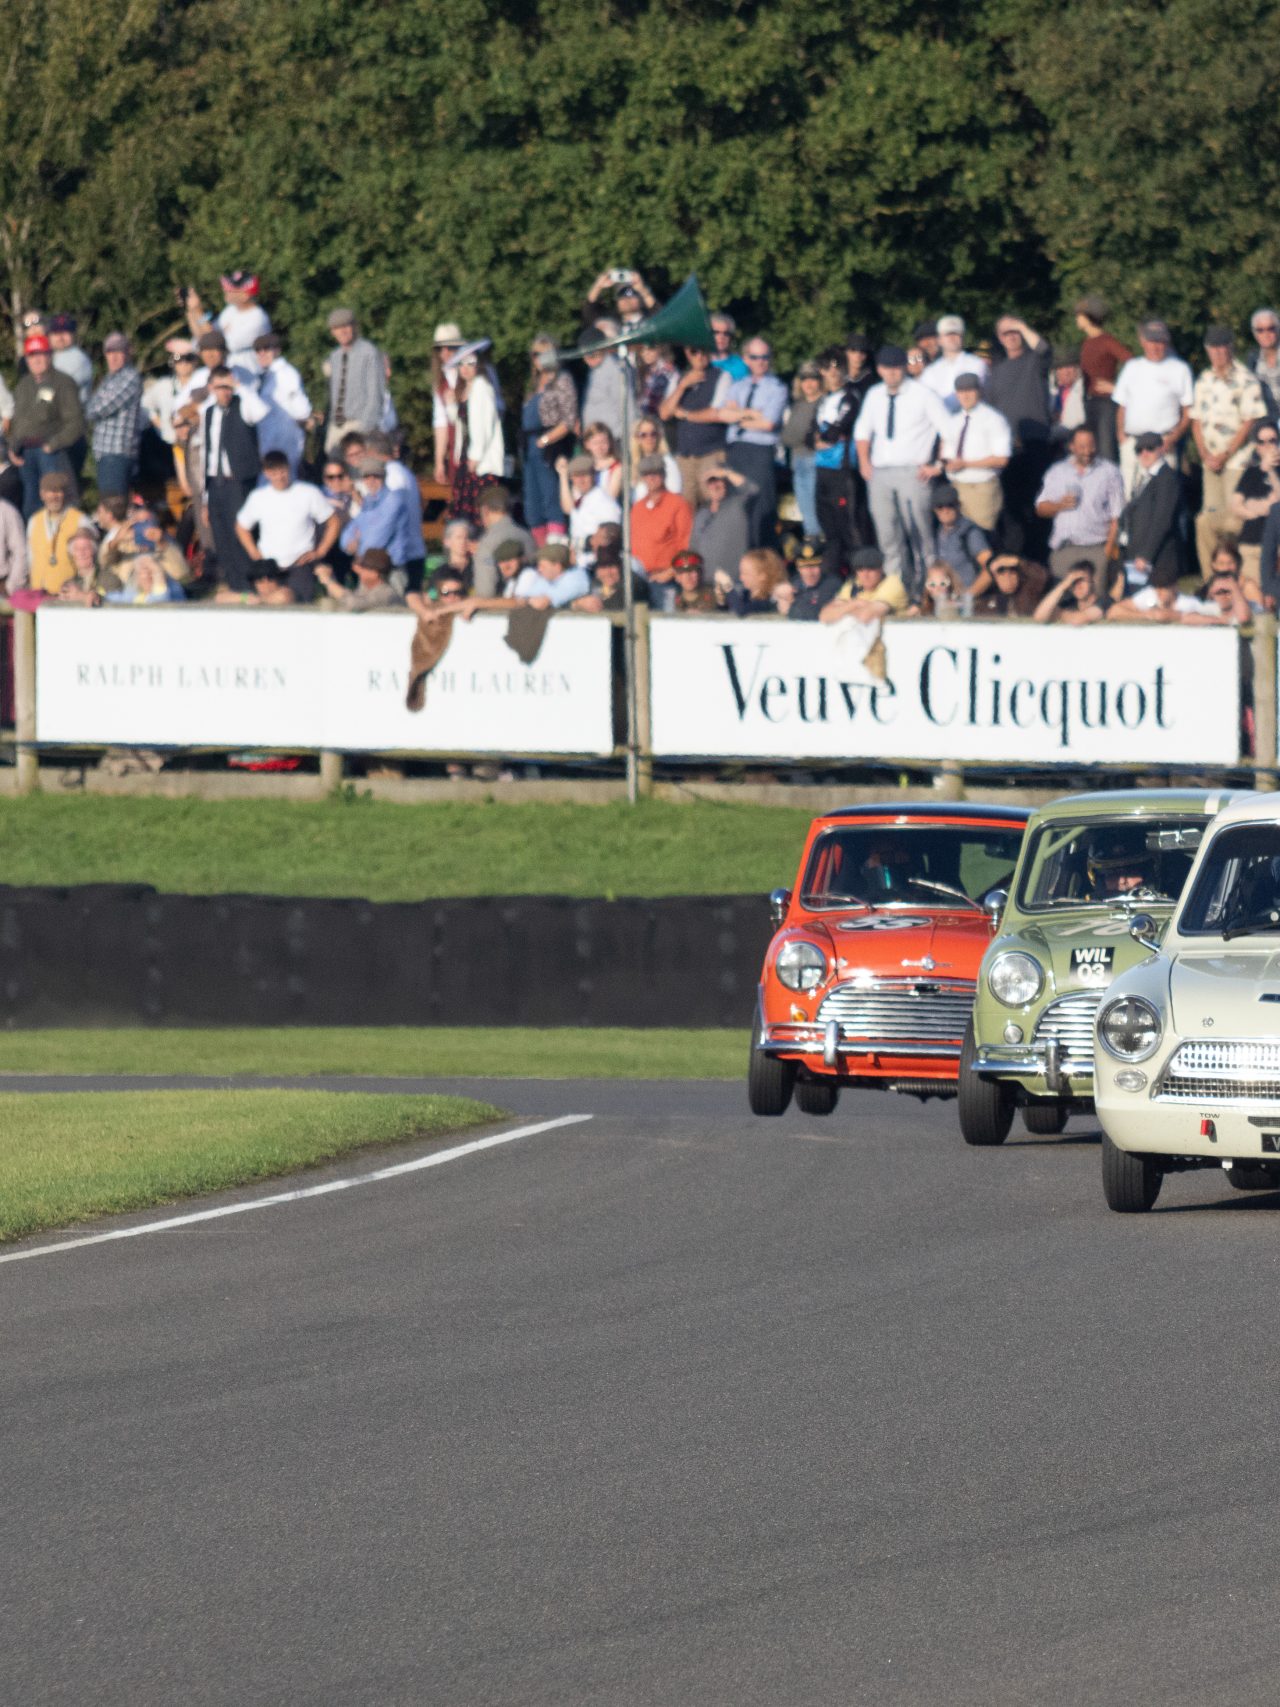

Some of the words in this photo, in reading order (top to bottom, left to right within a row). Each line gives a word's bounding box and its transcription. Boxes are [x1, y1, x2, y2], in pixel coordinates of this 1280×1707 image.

[77, 663, 163, 688] RALPH
[177, 664, 288, 691] LAUREN
[367, 669, 456, 693] RAH
[471, 670, 572, 695] LAUREN
[715, 643, 898, 725] Veuve
[918, 646, 1175, 747] Clicquot
[1074, 947, 1111, 963] WIL
[1077, 962, 1105, 982] 03
